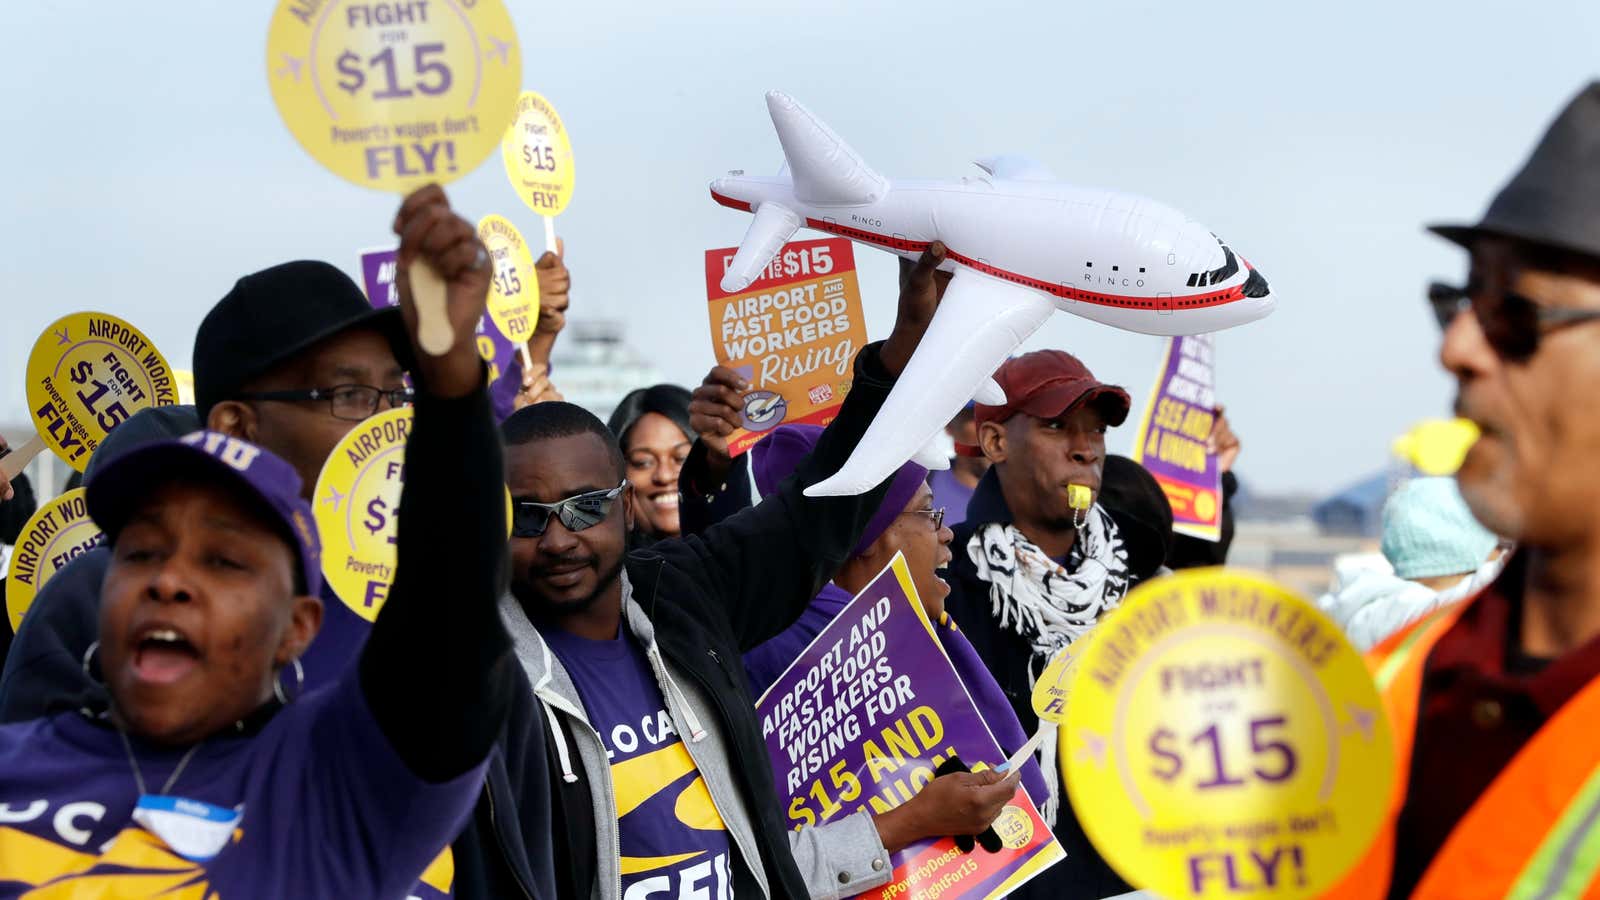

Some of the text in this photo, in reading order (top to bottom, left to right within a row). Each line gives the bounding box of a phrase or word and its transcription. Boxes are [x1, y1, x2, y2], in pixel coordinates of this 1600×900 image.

[346, 1, 430, 28] FIGHT
[335, 42, 454, 100] $15
[331, 125, 390, 144] Poverty
[394, 120, 438, 139] wages
[364, 140, 458, 180] FLY!
[522, 144, 556, 172] $15
[532, 190, 560, 210] FLY!
[851, 214, 882, 227] RINCO
[493, 267, 522, 297] $15
[783, 246, 834, 278] $15
[1084, 273, 1145, 288] RINCO
[722, 283, 845, 322] AIRPORT AND
[722, 297, 848, 342] FAST FOOD
[88, 318, 147, 356] AIRPORT
[508, 315, 530, 336] FLY!
[724, 314, 850, 362] WORKERS
[102, 351, 146, 403] FIGHT
[760, 338, 857, 389] Rising
[41, 376, 69, 413] Poverty
[66, 411, 89, 440] wages
[70, 360, 131, 434] $15
[107, 379, 122, 397] FOR
[36, 401, 87, 462] FLY!
[15, 511, 59, 585] AIRPORT
[346, 555, 392, 580] Poverty
[763, 596, 891, 741] AIRPORT AND
[778, 630, 886, 750] FAST FOOD
[1160, 658, 1265, 695] FIGHT
[787, 656, 893, 766] WORKERS
[786, 673, 916, 797] RISING FOR
[1148, 715, 1299, 791] $15
[787, 705, 944, 832] $15 AND
[1188, 844, 1307, 894] FLY!
